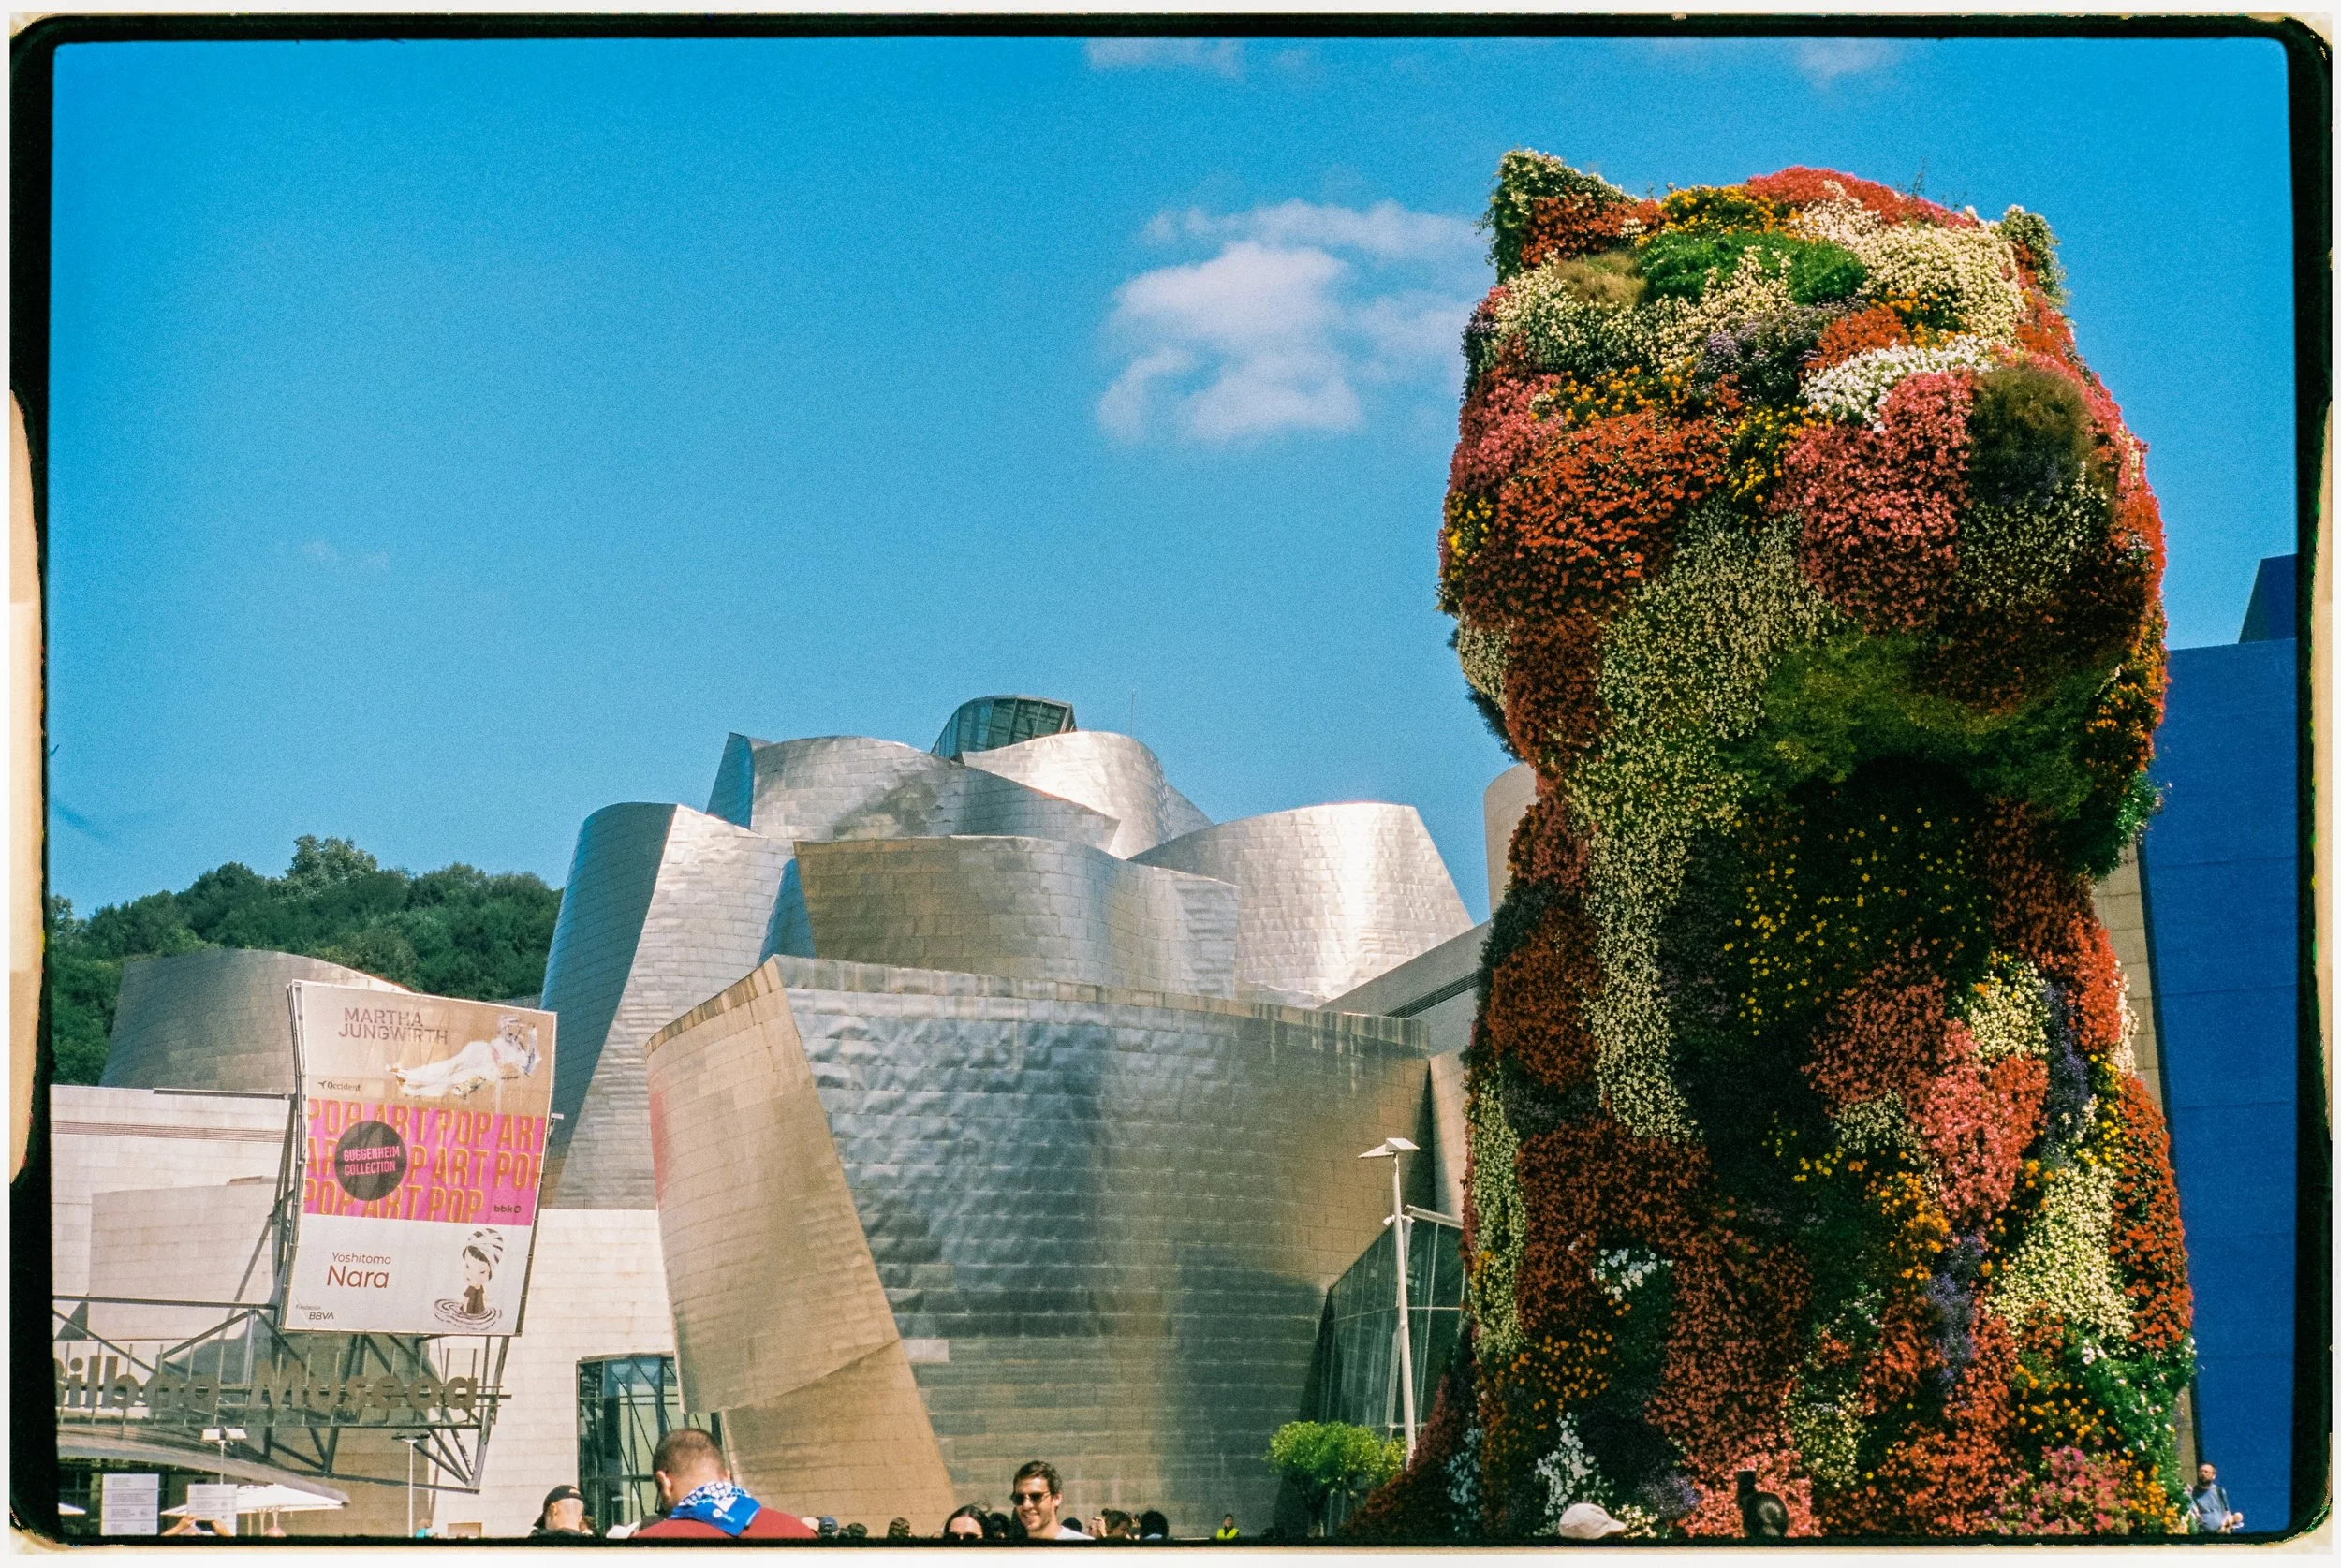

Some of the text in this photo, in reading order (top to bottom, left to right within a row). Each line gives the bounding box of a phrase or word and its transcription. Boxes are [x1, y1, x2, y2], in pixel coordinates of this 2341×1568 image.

[344, 1007, 423, 1027] MARTHA
[338, 1023, 449, 1045] JUNGWIRTH
[327, 1081, 361, 1092] Occident
[343, 1145, 401, 1163] GUGGENHEIM
[344, 1160, 397, 1177] COLLECTION
[433, 1147, 490, 1187] ART
[428, 1186, 484, 1224] POP
[493, 1204, 513, 1213] bbk
[331, 1252, 391, 1265] Yoshitomo
[327, 1265, 390, 1289] Nara
[309, 1311, 334, 1321] BBVA
